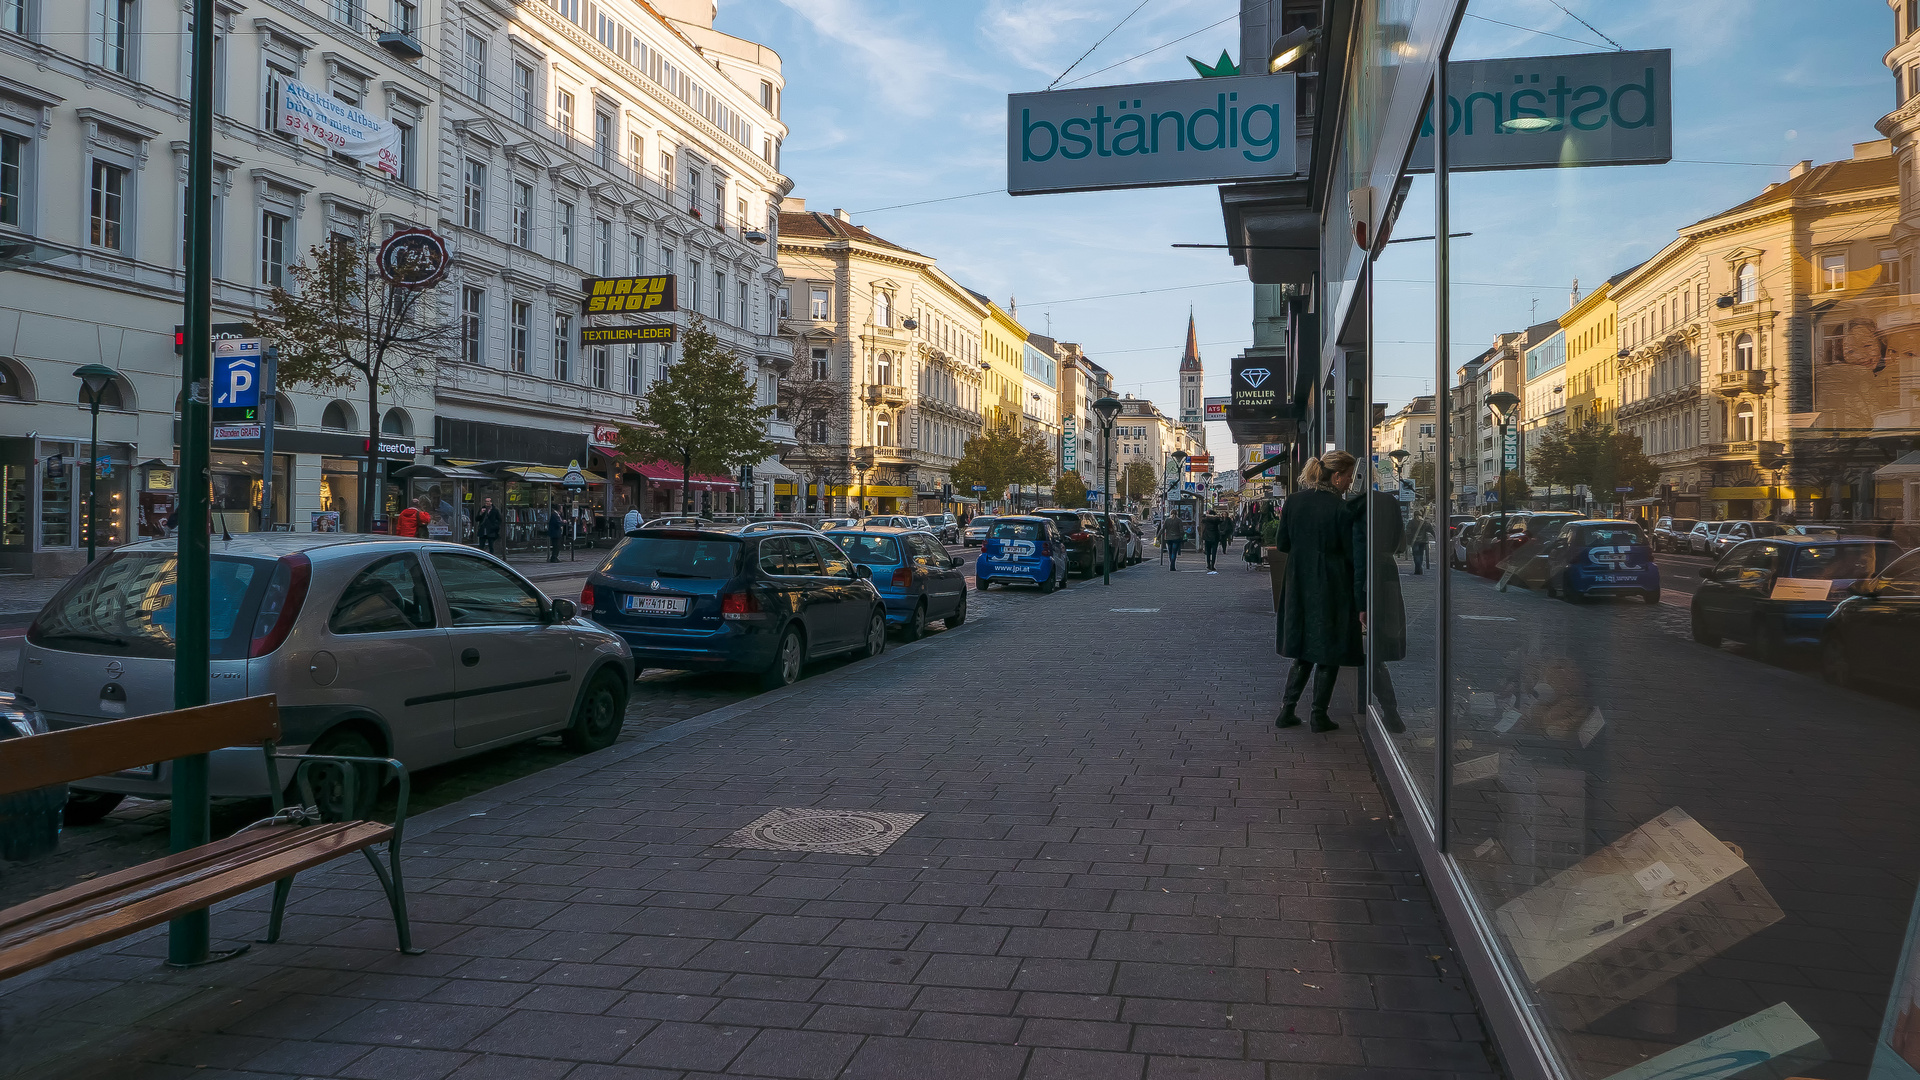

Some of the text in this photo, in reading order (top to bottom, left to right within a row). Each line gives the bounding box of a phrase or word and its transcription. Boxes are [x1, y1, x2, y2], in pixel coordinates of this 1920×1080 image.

[286, 83, 381, 132] Attraktives Altbau-
[286, 97, 366, 141] büro zu mieten.
[1021, 92, 1280, 162] bständig
[592, 277, 667, 296] MAZU
[588, 293, 663, 312] SHOP
[582, 328, 671, 341] TEXTILIEN-LEDER
[230, 370, 252, 404] P
[1236, 390, 1275, 399] JUWELIER
[215, 427, 260, 438] 2 Stunden GRATIS
[399, 443, 415, 454] One
[994, 565, 1030, 573] www.jpi.at
[638, 597, 644, 608] W
